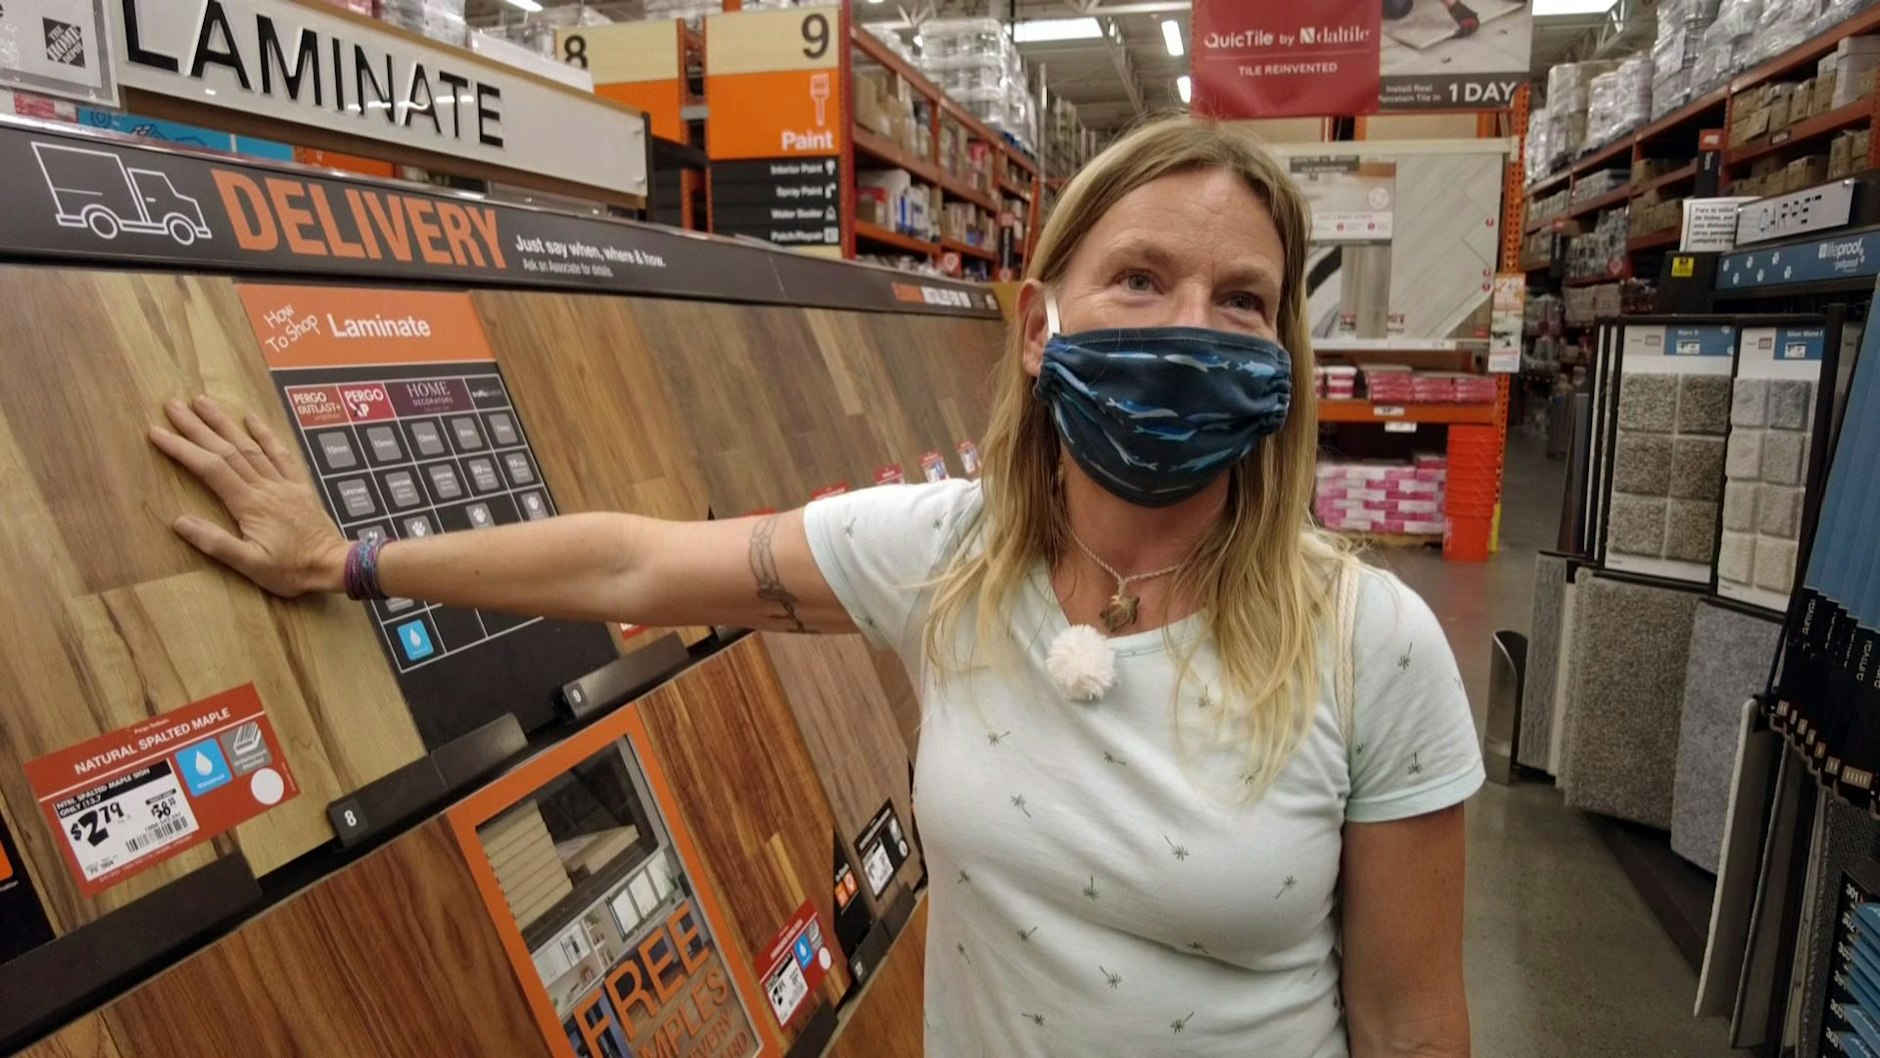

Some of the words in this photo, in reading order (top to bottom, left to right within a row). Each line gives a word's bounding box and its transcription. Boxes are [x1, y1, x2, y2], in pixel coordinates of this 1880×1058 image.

[47, 25, 80, 62] HOME
[802, 13, 829, 59] 9
[1204, 31, 1274, 49] QuicTile
[1279, 34, 1295, 47] by
[1317, 26, 1371, 44] daltile
[564, 35, 588, 69] 8
[122, 0, 504, 148] LAMINATE
[1238, 66, 1262, 77] TILE
[1264, 62, 1338, 75] REINVENTED
[1448, 82, 1458, 103] 1
[1464, 81, 1518, 103] DAY
[781, 130, 834, 150] Paint
[210, 168, 507, 269] DELIVERY
[515, 234, 546, 254] Just
[545, 241, 568, 258] say
[603, 246, 636, 264] where
[263, 304, 296, 328] How
[327, 313, 432, 338] Laminate
[265, 336, 289, 352] To
[286, 315, 320, 341] Shop
[293, 391, 328, 404] PERGO
[343, 388, 384, 402] PERGO
[406, 381, 448, 398] HOME
[74, 744, 137, 774] NATURAL
[138, 724, 191, 751] SPALTED
[190, 707, 231, 731] MAPLE
[344, 809, 357, 827] 8
[573, 901, 711, 1058] FREE
